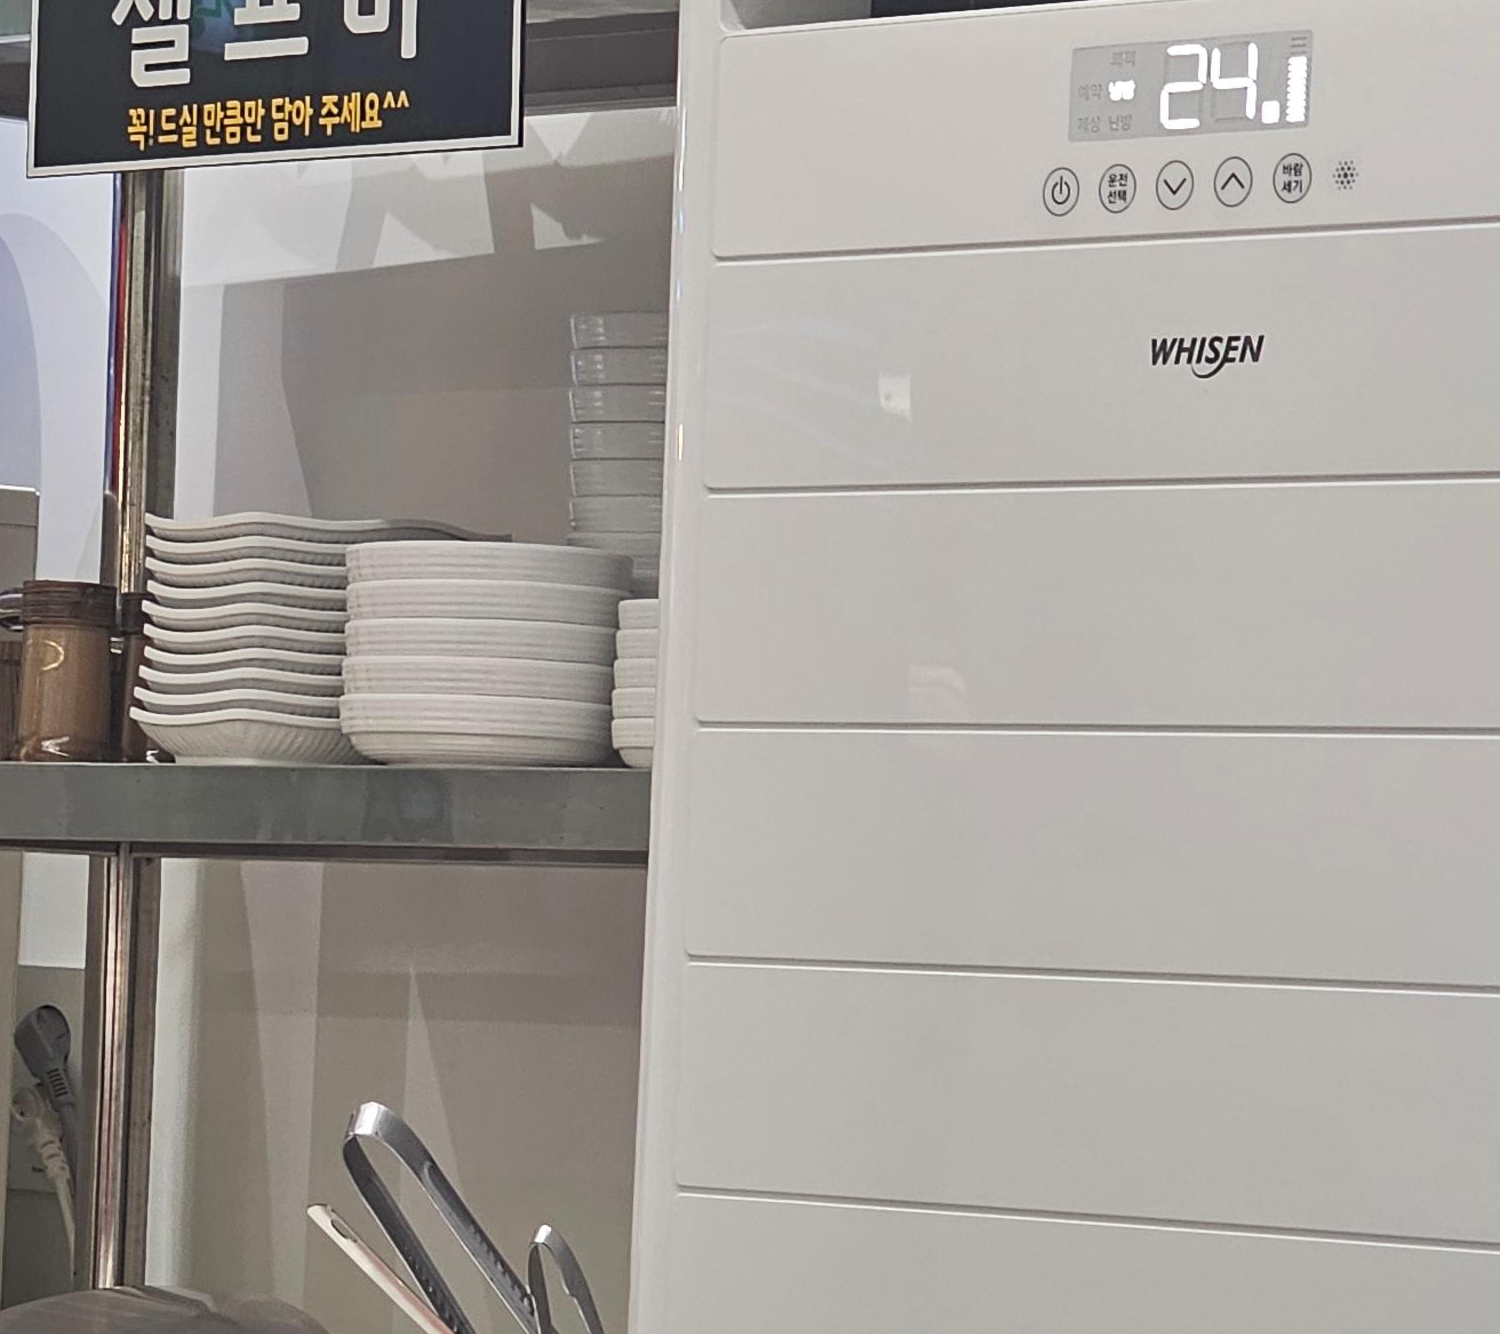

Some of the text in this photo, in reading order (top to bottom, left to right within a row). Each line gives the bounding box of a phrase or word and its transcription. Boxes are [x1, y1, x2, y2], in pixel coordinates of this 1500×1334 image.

[271, 95, 313, 141] 담아
[1108, 172, 1128, 188] 운전
[1281, 179, 1303, 193] 세기
[1150, 334, 1265, 378] WHISEN
